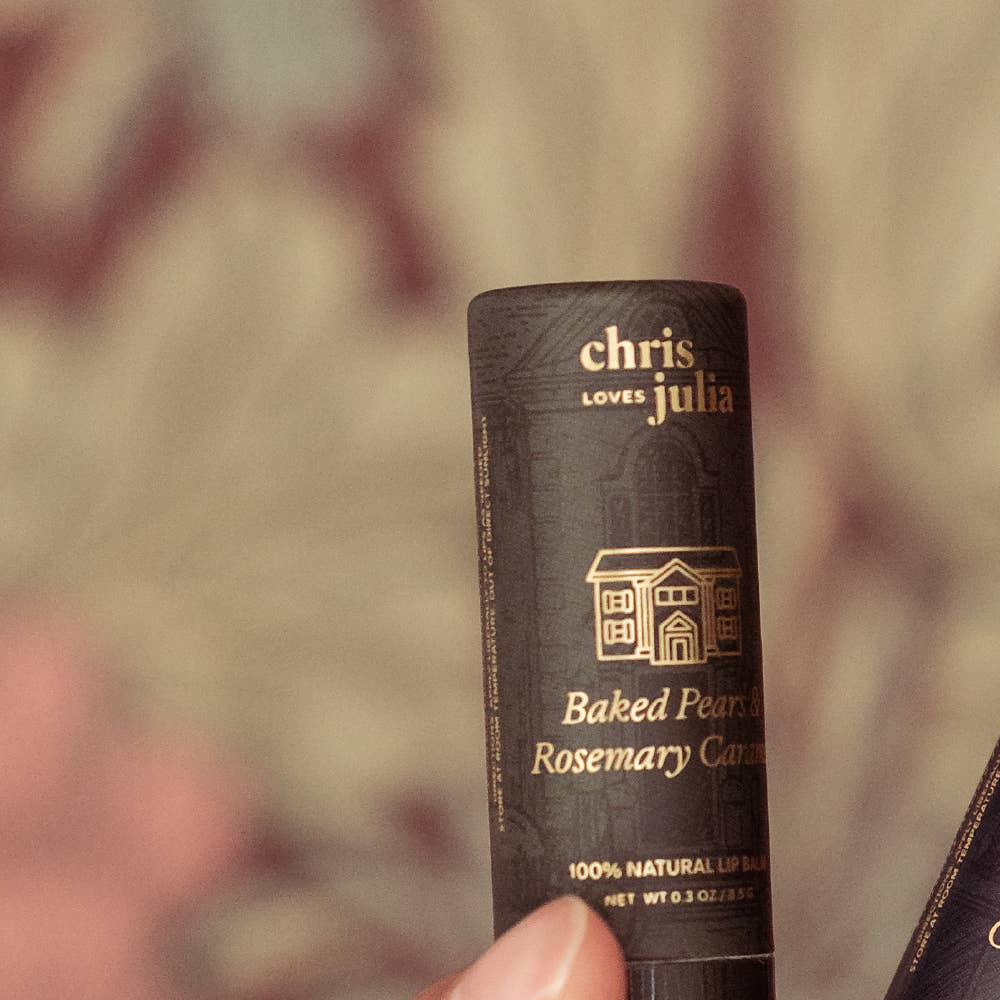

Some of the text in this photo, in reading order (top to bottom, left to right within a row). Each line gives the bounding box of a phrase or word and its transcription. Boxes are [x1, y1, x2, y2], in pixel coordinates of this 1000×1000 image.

[579, 325, 695, 372] chris
[581, 369, 734, 426] LOVES julia
[561, 687, 671, 725] Baked
[675, 687, 747, 720] Pears
[531, 742, 691, 778] Rosemary
[569, 861, 622, 880] 100%
[626, 858, 715, 878] NATURAL
[717, 857, 739, 874] LIP
[604, 892, 635, 907] NET
[643, 891, 667, 905] WT
[908, 930, 931, 973] STORE
[928, 911, 940, 928] AT
[936, 866, 959, 908] ROOM
